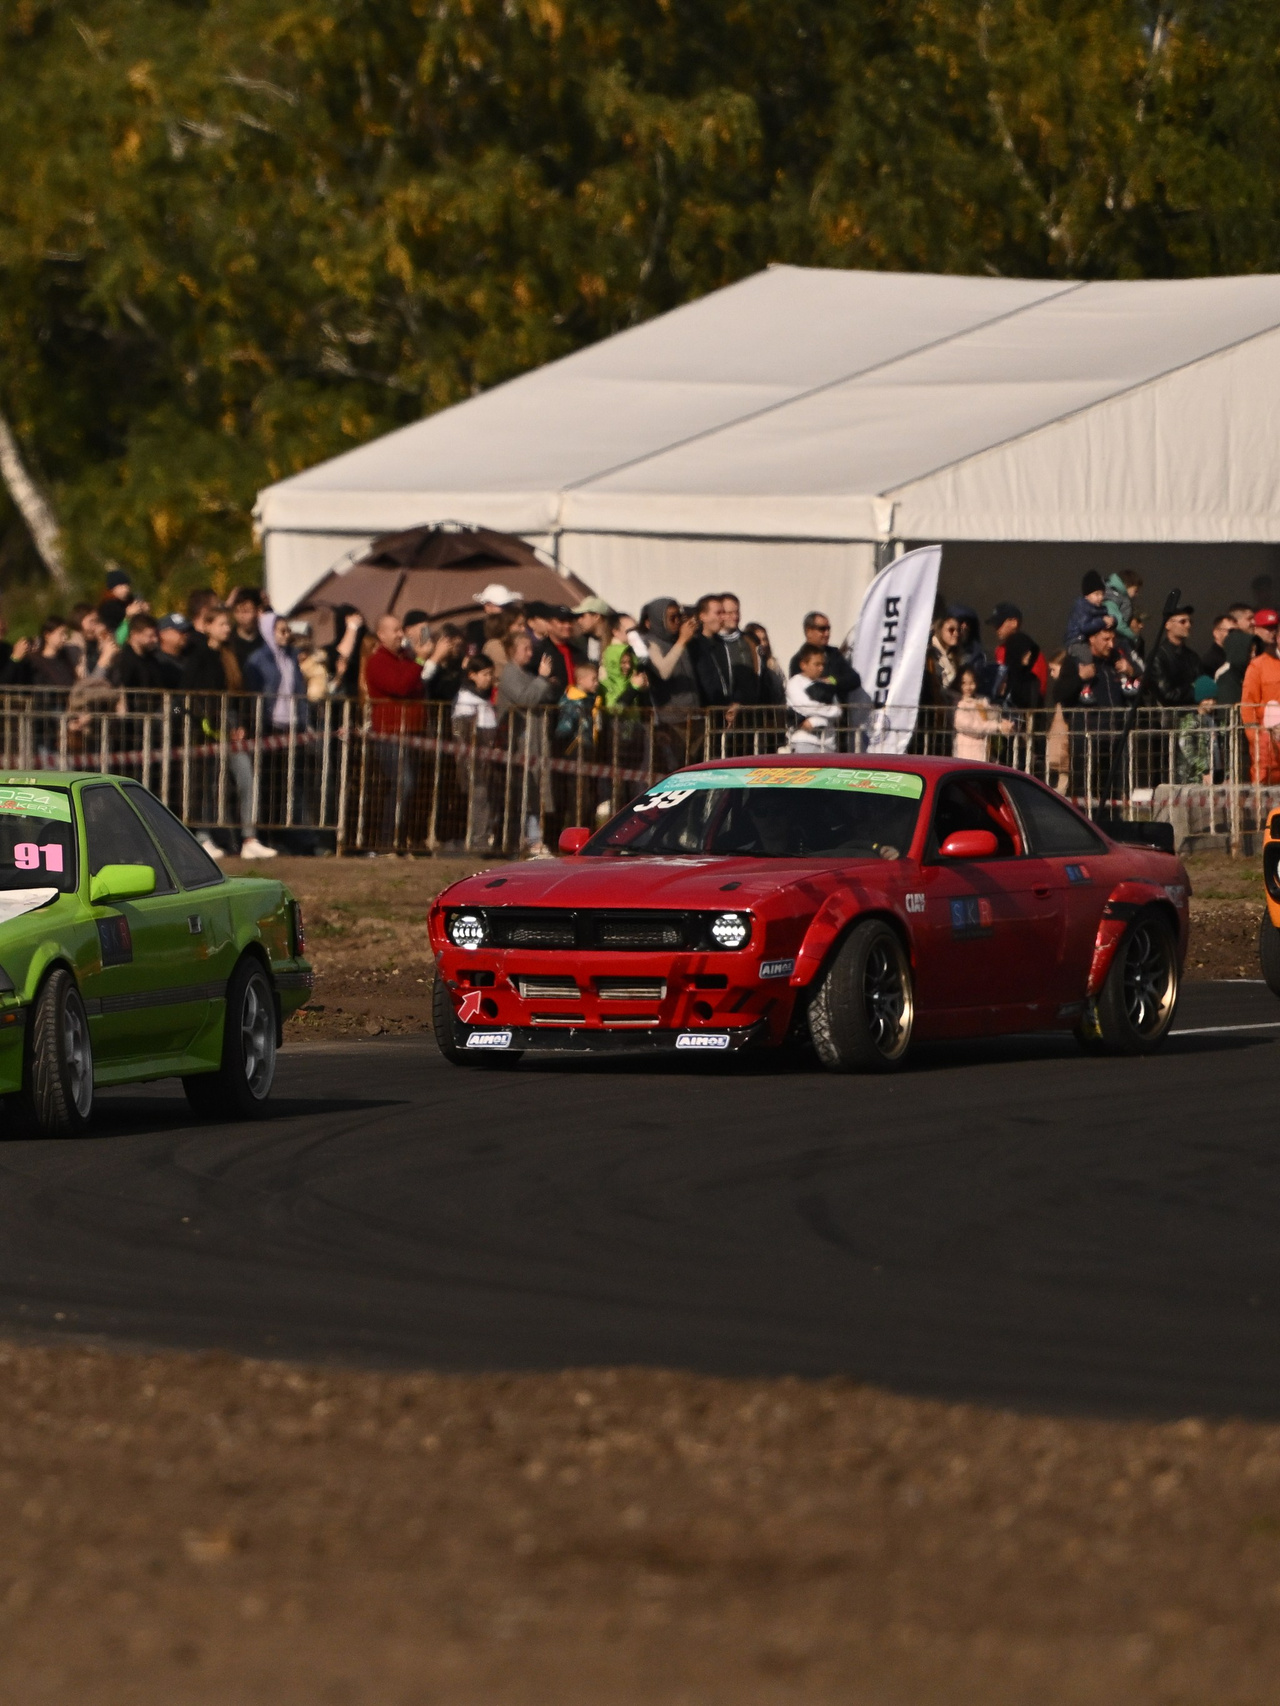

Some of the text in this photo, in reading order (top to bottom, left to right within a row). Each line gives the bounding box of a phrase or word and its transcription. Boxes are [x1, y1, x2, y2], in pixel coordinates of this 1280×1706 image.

[836, 769, 903, 782] 2024
[633, 789, 696, 812] 39
[14, 843, 64, 872] 91
[762, 961, 793, 975] AIMOL
[469, 1035, 510, 1045] AIMOL
[679, 1036, 727, 1046] AIMOL
